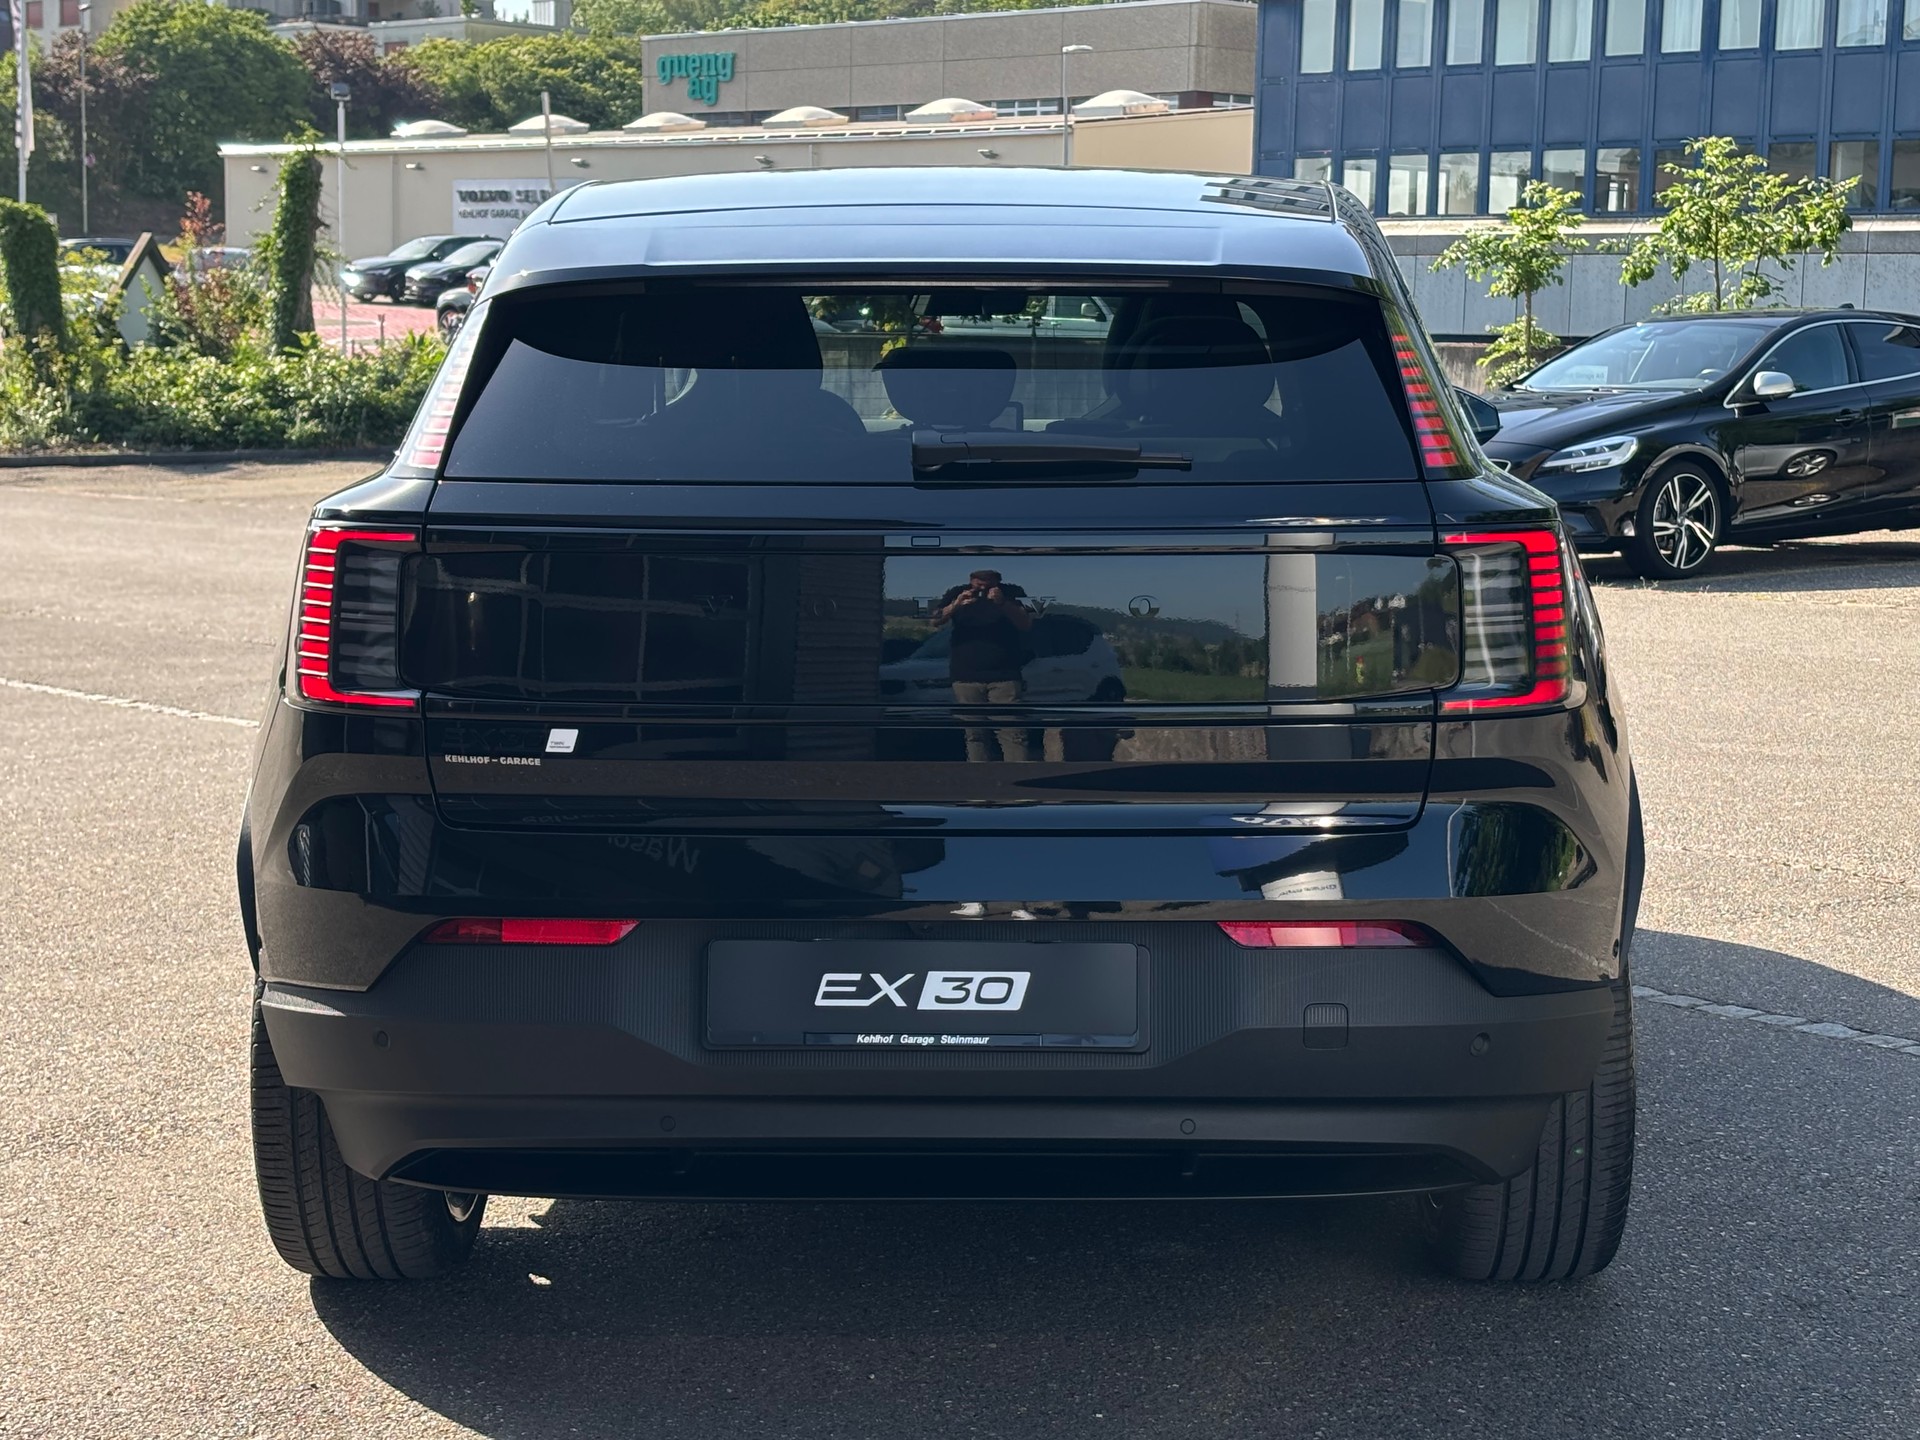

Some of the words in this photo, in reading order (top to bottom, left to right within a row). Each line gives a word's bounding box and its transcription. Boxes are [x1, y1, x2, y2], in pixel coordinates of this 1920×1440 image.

[656, 52, 735, 85] gueng
[687, 77, 718, 106] ag
[457, 189, 512, 202] VOLVO
[444, 754, 491, 765] KEHLHOF
[499, 756, 542, 766] GARAGE
[856, 1034, 894, 1045] Kehlhof
[900, 1034, 935, 1046] Garage
[940, 1034, 990, 1046] Steinmaur
